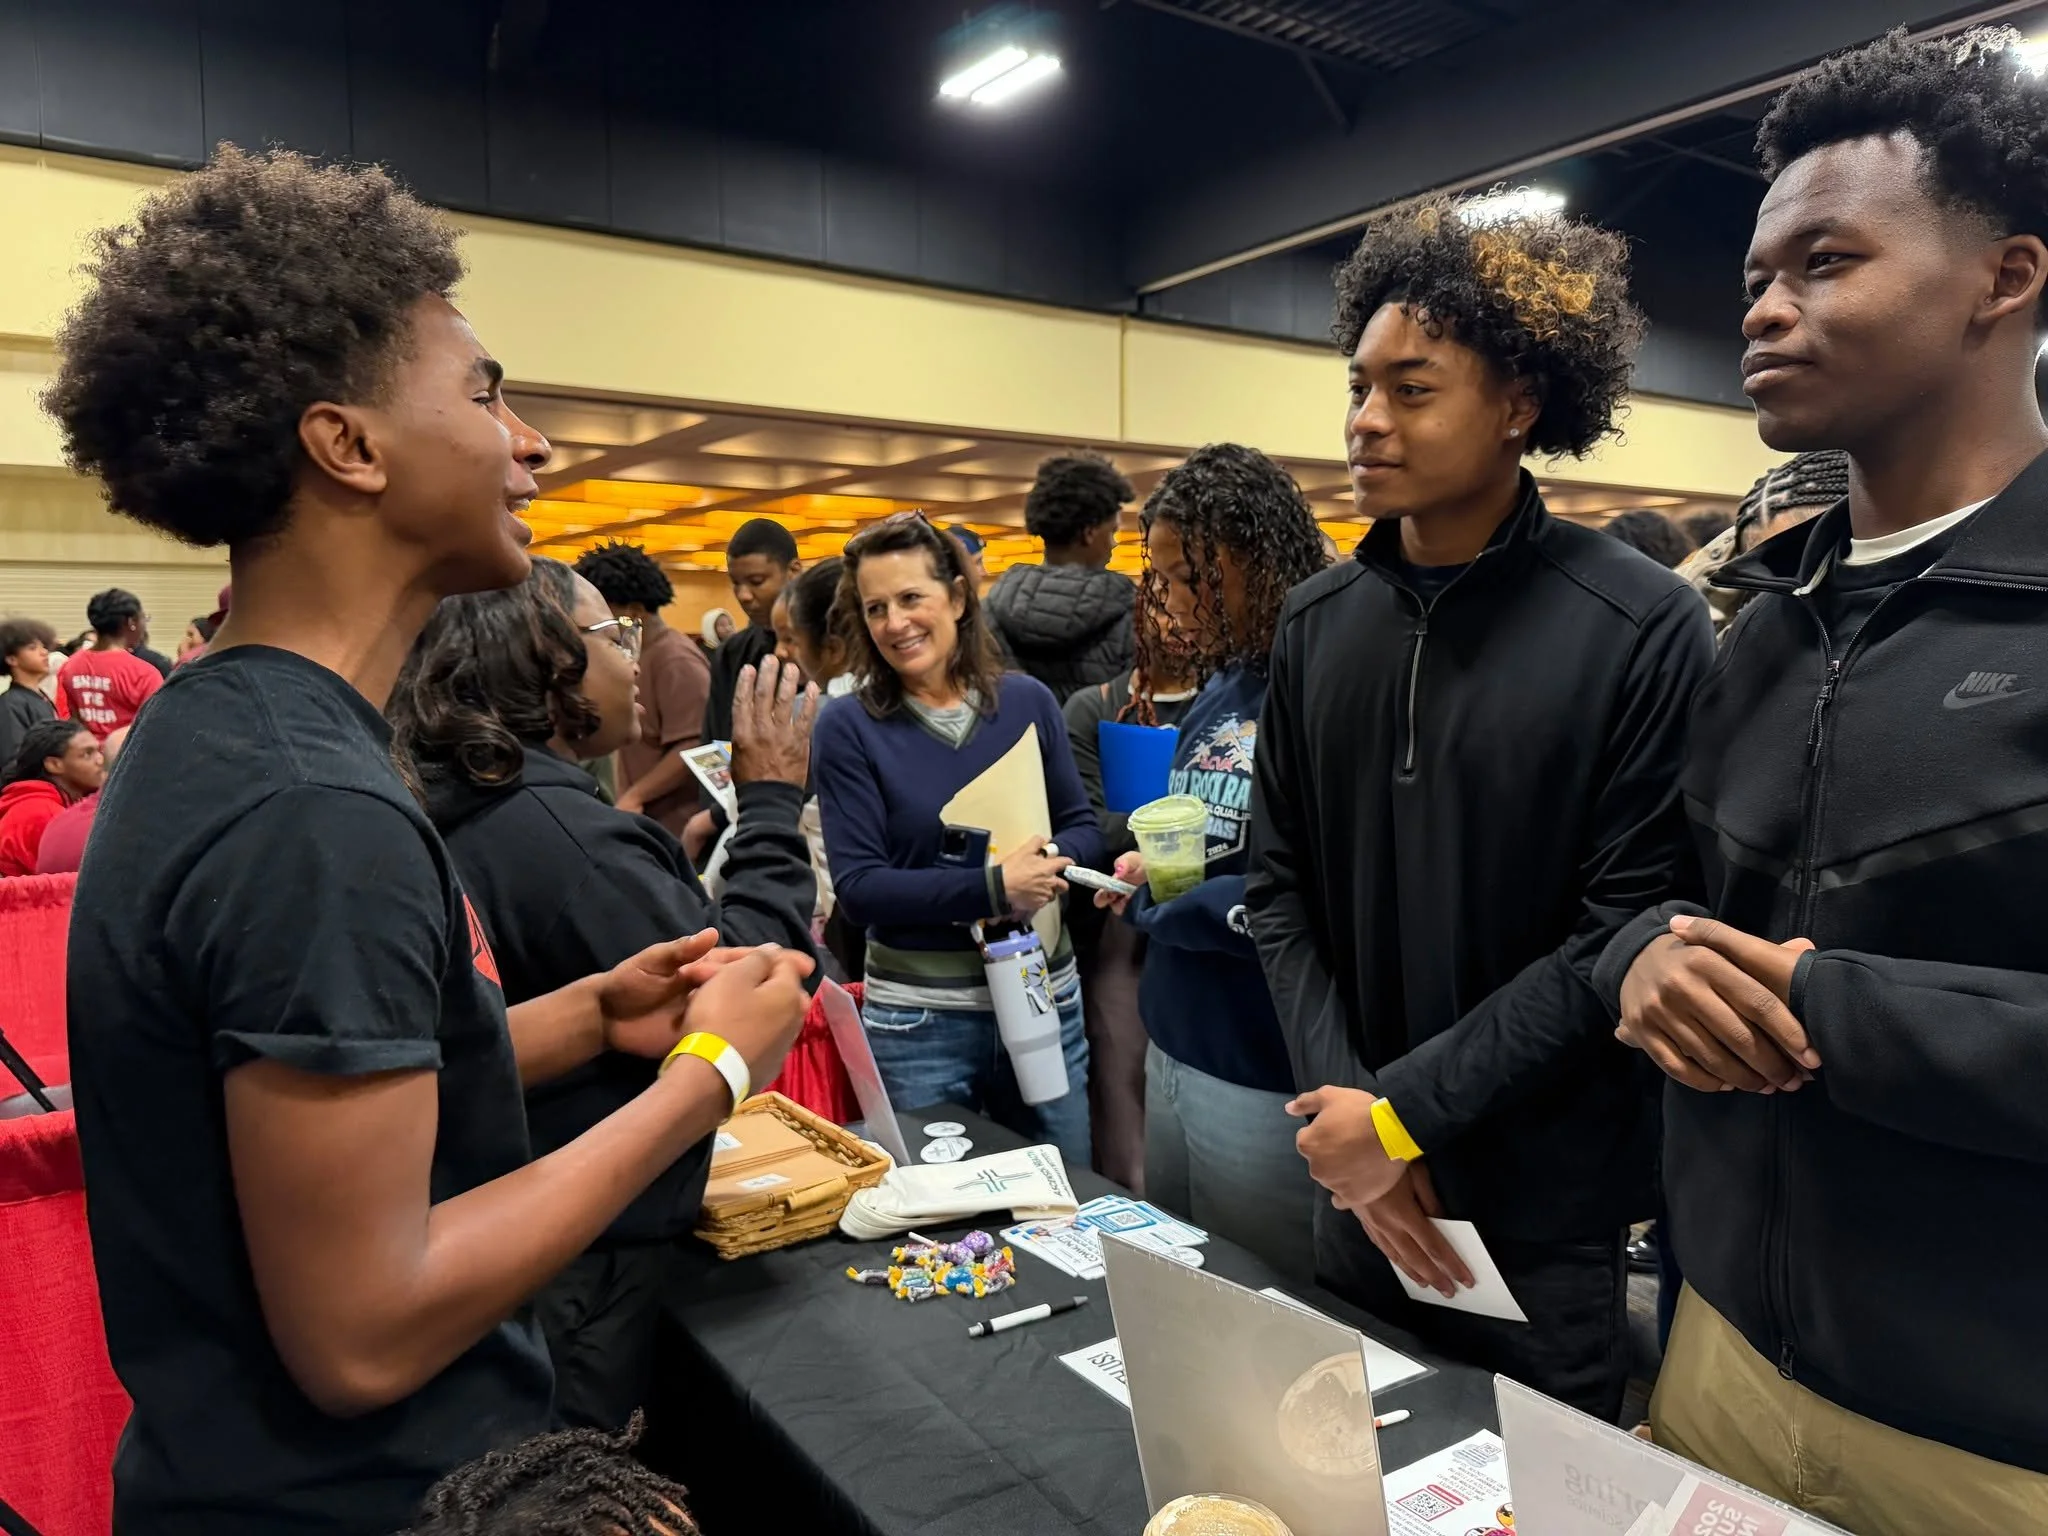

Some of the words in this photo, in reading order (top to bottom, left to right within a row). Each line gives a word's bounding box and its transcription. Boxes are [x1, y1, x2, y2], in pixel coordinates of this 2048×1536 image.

[1957, 671, 2018, 693] NIKE
[1190, 769, 1225, 804] ROCK
[1220, 773, 1253, 811] RA
[1206, 842, 1229, 856] 2024
